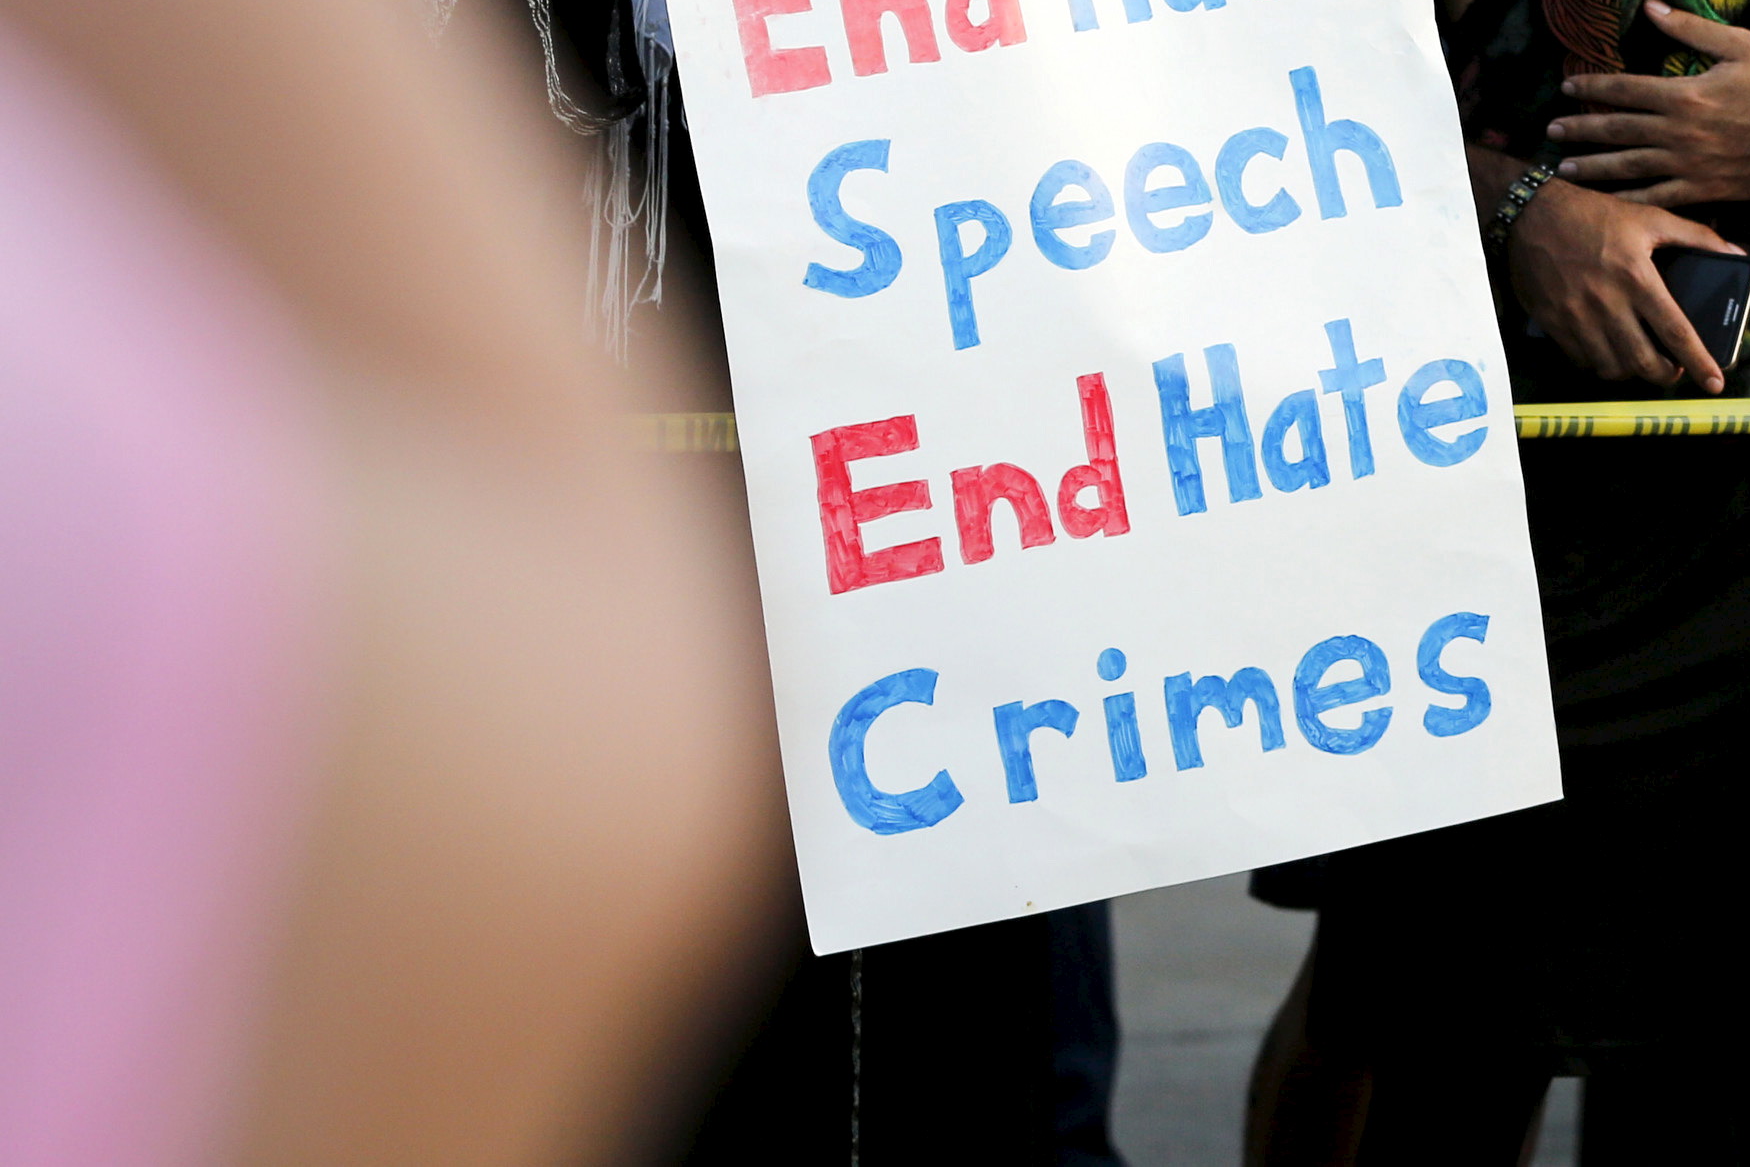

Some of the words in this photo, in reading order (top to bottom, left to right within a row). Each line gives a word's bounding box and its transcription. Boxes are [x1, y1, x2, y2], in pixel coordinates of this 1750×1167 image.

[802, 65, 1404, 351] Speech
[809, 371, 1131, 596] End
[1151, 318, 1490, 517] Hate
[828, 611, 1493, 836] Crimes
